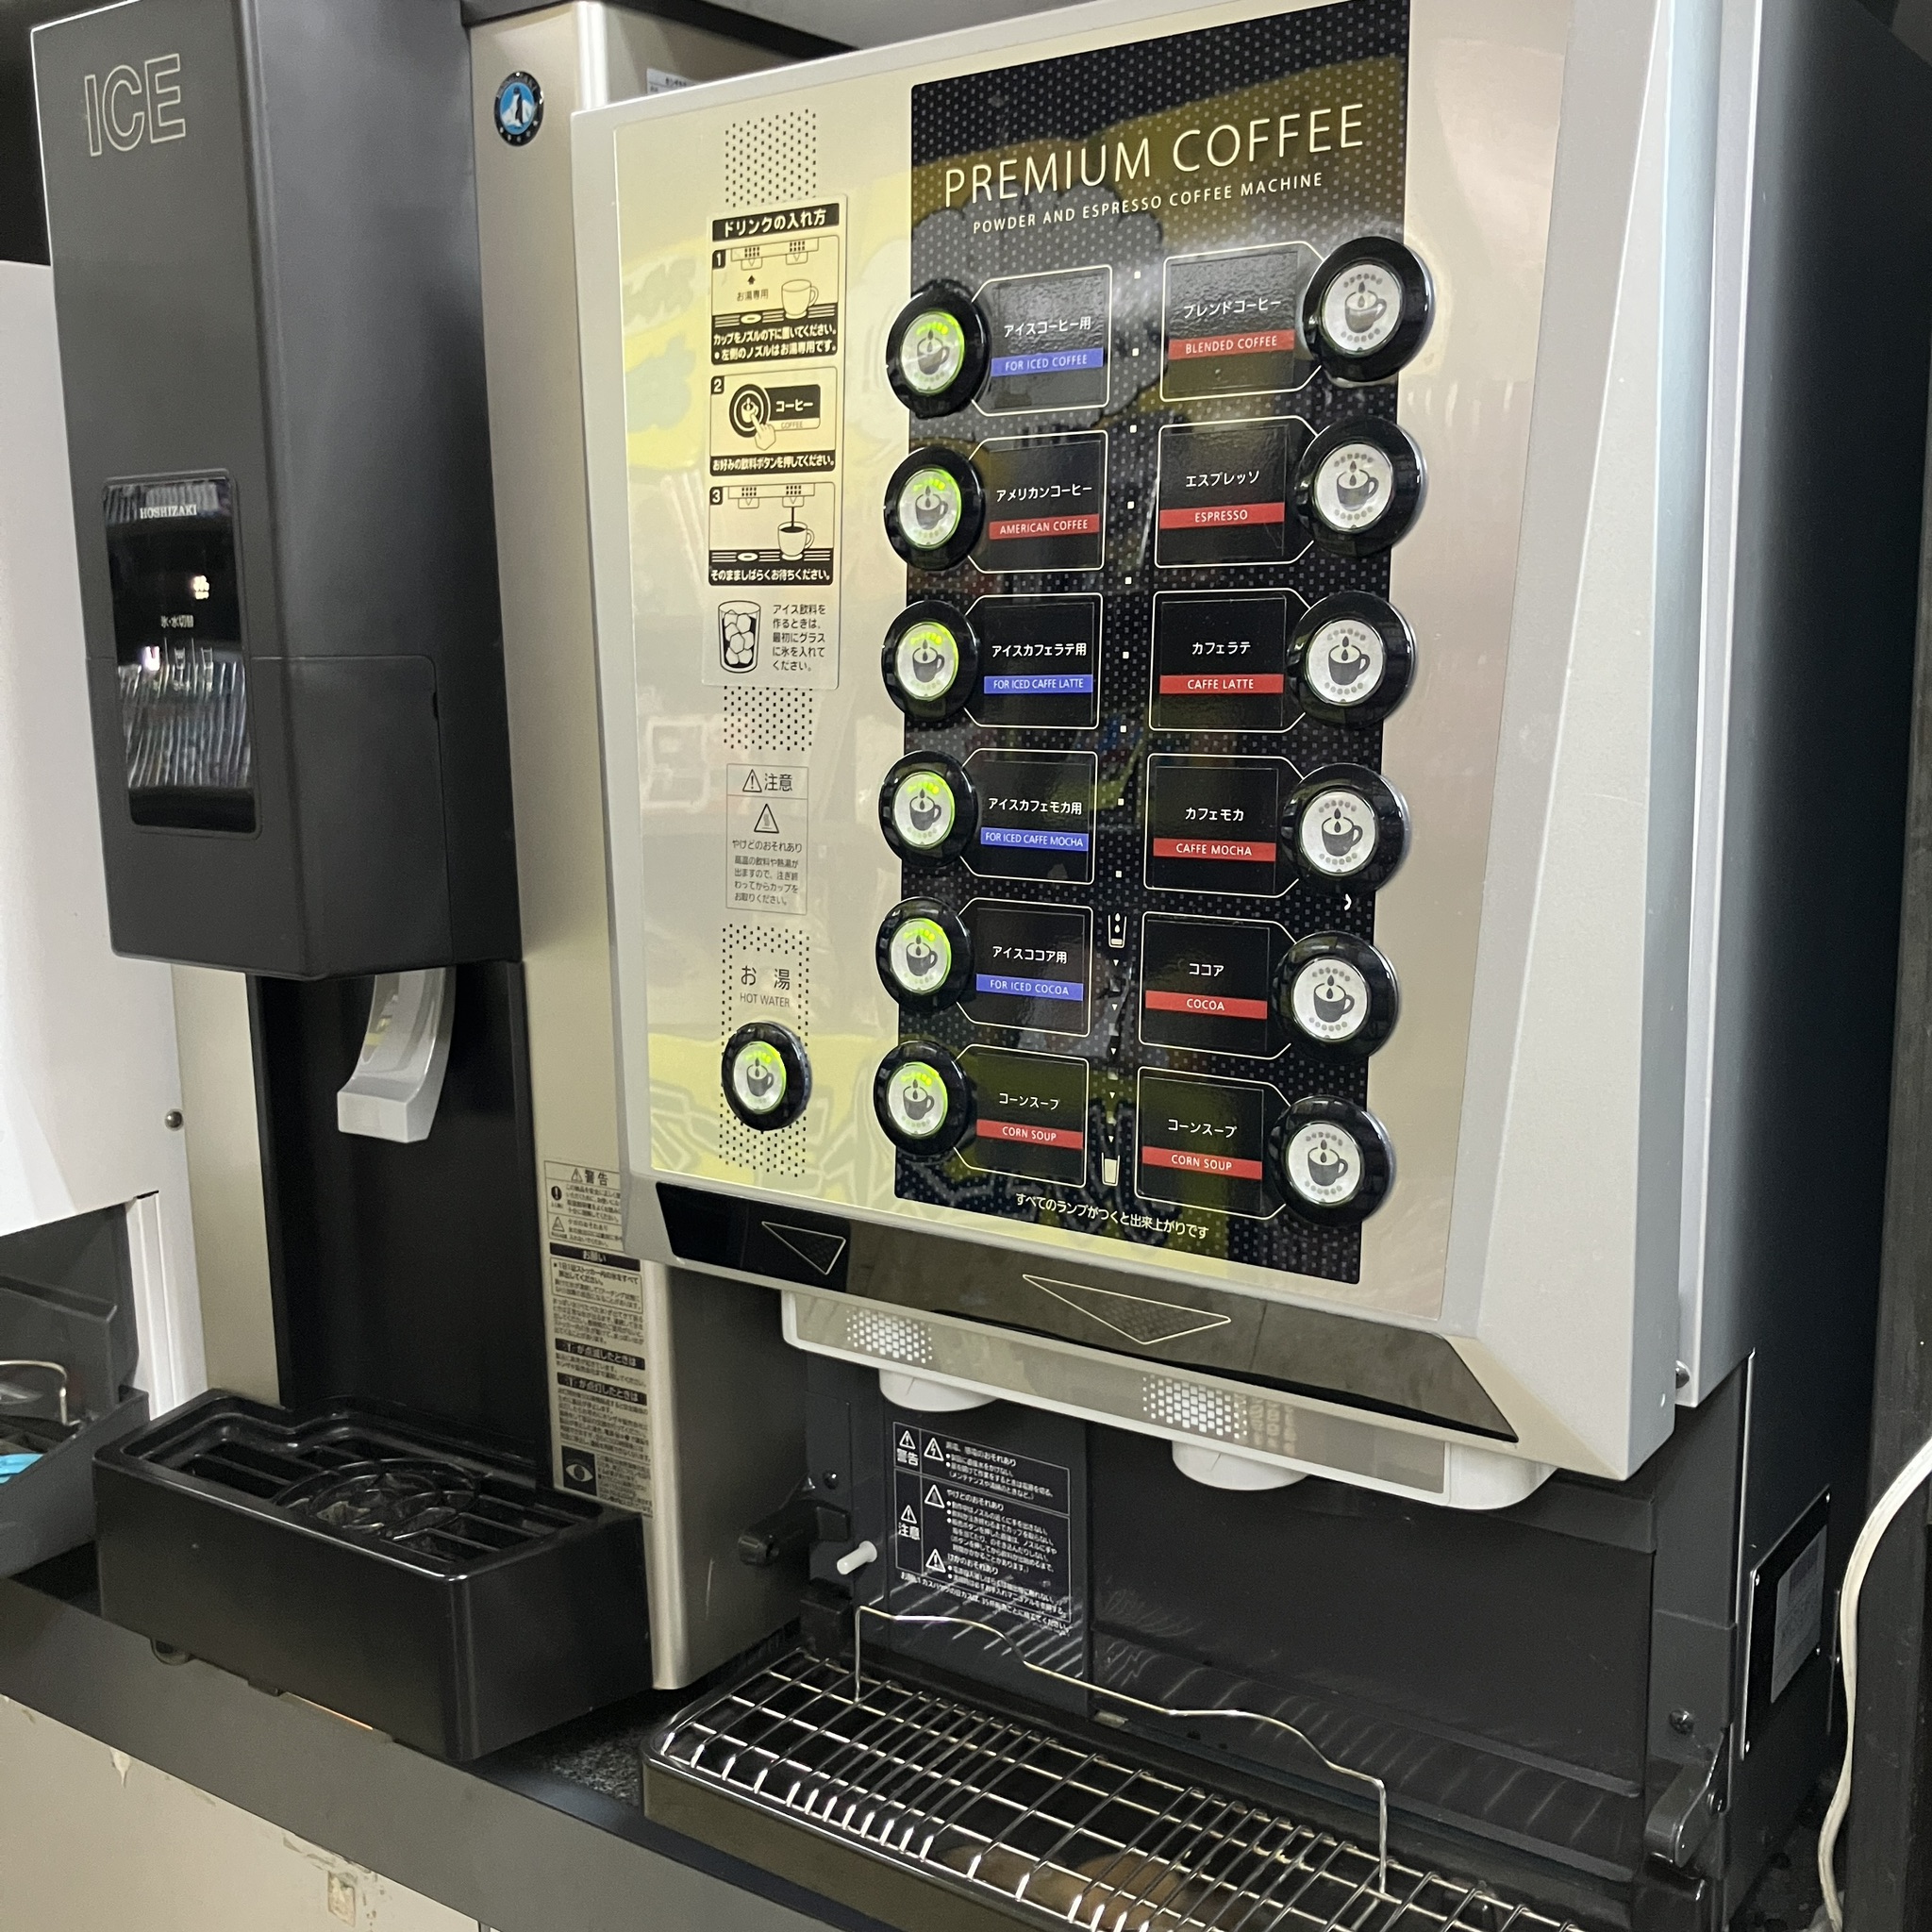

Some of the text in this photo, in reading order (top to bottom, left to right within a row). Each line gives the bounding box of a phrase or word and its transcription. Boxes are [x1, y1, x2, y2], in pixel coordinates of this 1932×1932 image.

[85, 53, 186, 157] ICE
[945, 103, 1363, 208] PREMIUM COFFEE
[973, 172, 1323, 234] POWDER AND ESPRESSO COFFEE MACHINE
[724, 208, 826, 238] ドリンクの入れ方
[736, 289, 769, 302] お湯専用
[1183, 296, 1282, 319] ブレンドコーヒー
[1004, 316, 1091, 338] アイスコーヒー用
[1185, 335, 1277, 355] BLENDED COFFEE
[1005, 354, 1088, 372] FOR ICED COFFEE
[775, 398, 814, 412] コーヒー
[780, 421, 803, 429] COFFEE
[1185, 470, 1260, 488] エスプレッソ
[996, 483, 1092, 503] アメリカンコーヒー
[140, 504, 197, 519] HOSHIZAKI
[1194, 509, 1248, 523] ESPRESSO
[1000, 519, 1088, 535] AMERICAN COFFEE
[710, 568, 831, 581] そのまましばらくお待ちください。
[773, 604, 826, 615] アイス飲料を
[773, 632, 825, 643] 最初にグラス
[773, 646, 825, 658] に氷を入れて
[991, 642, 1087, 658] アイスカフェラテ用
[1191, 641, 1252, 655] カフェラテ
[773, 660, 812, 672] ください。
[993, 678, 1084, 690] FOR ICED CAFFE LATTE
[1187, 678, 1254, 690] CAFFE LATTE
[764, 773, 793, 791] 注意
[988, 797, 1082, 815] アイスカフェモカ用
[1185, 807, 1244, 822] カフェモカ
[732, 839, 803, 854] やけどのおそれあり
[985, 831, 1083, 847] FOR ICED CAFFE MOCHA
[1176, 843, 1253, 856] CAFFE MOCHA
[734, 880, 799, 894] わってからカップを
[992, 945, 1068, 964] アイスココア用
[1189, 962, 1224, 977] ココア
[990, 979, 1070, 995] FOR ICED COCOA
[740, 992, 791, 1008] HOT WATER
[1186, 998, 1224, 1011] COCOA
[999, 1092, 1060, 1110] コーンスープ
[1002, 1125, 1057, 1141] CORN SOUP
[1168, 1118, 1238, 1139] コーンスープ
[1171, 1154, 1232, 1171] CORN SOUP
[1016, 1192, 1209, 1240] すべてのランプがつくと出来上がりです
